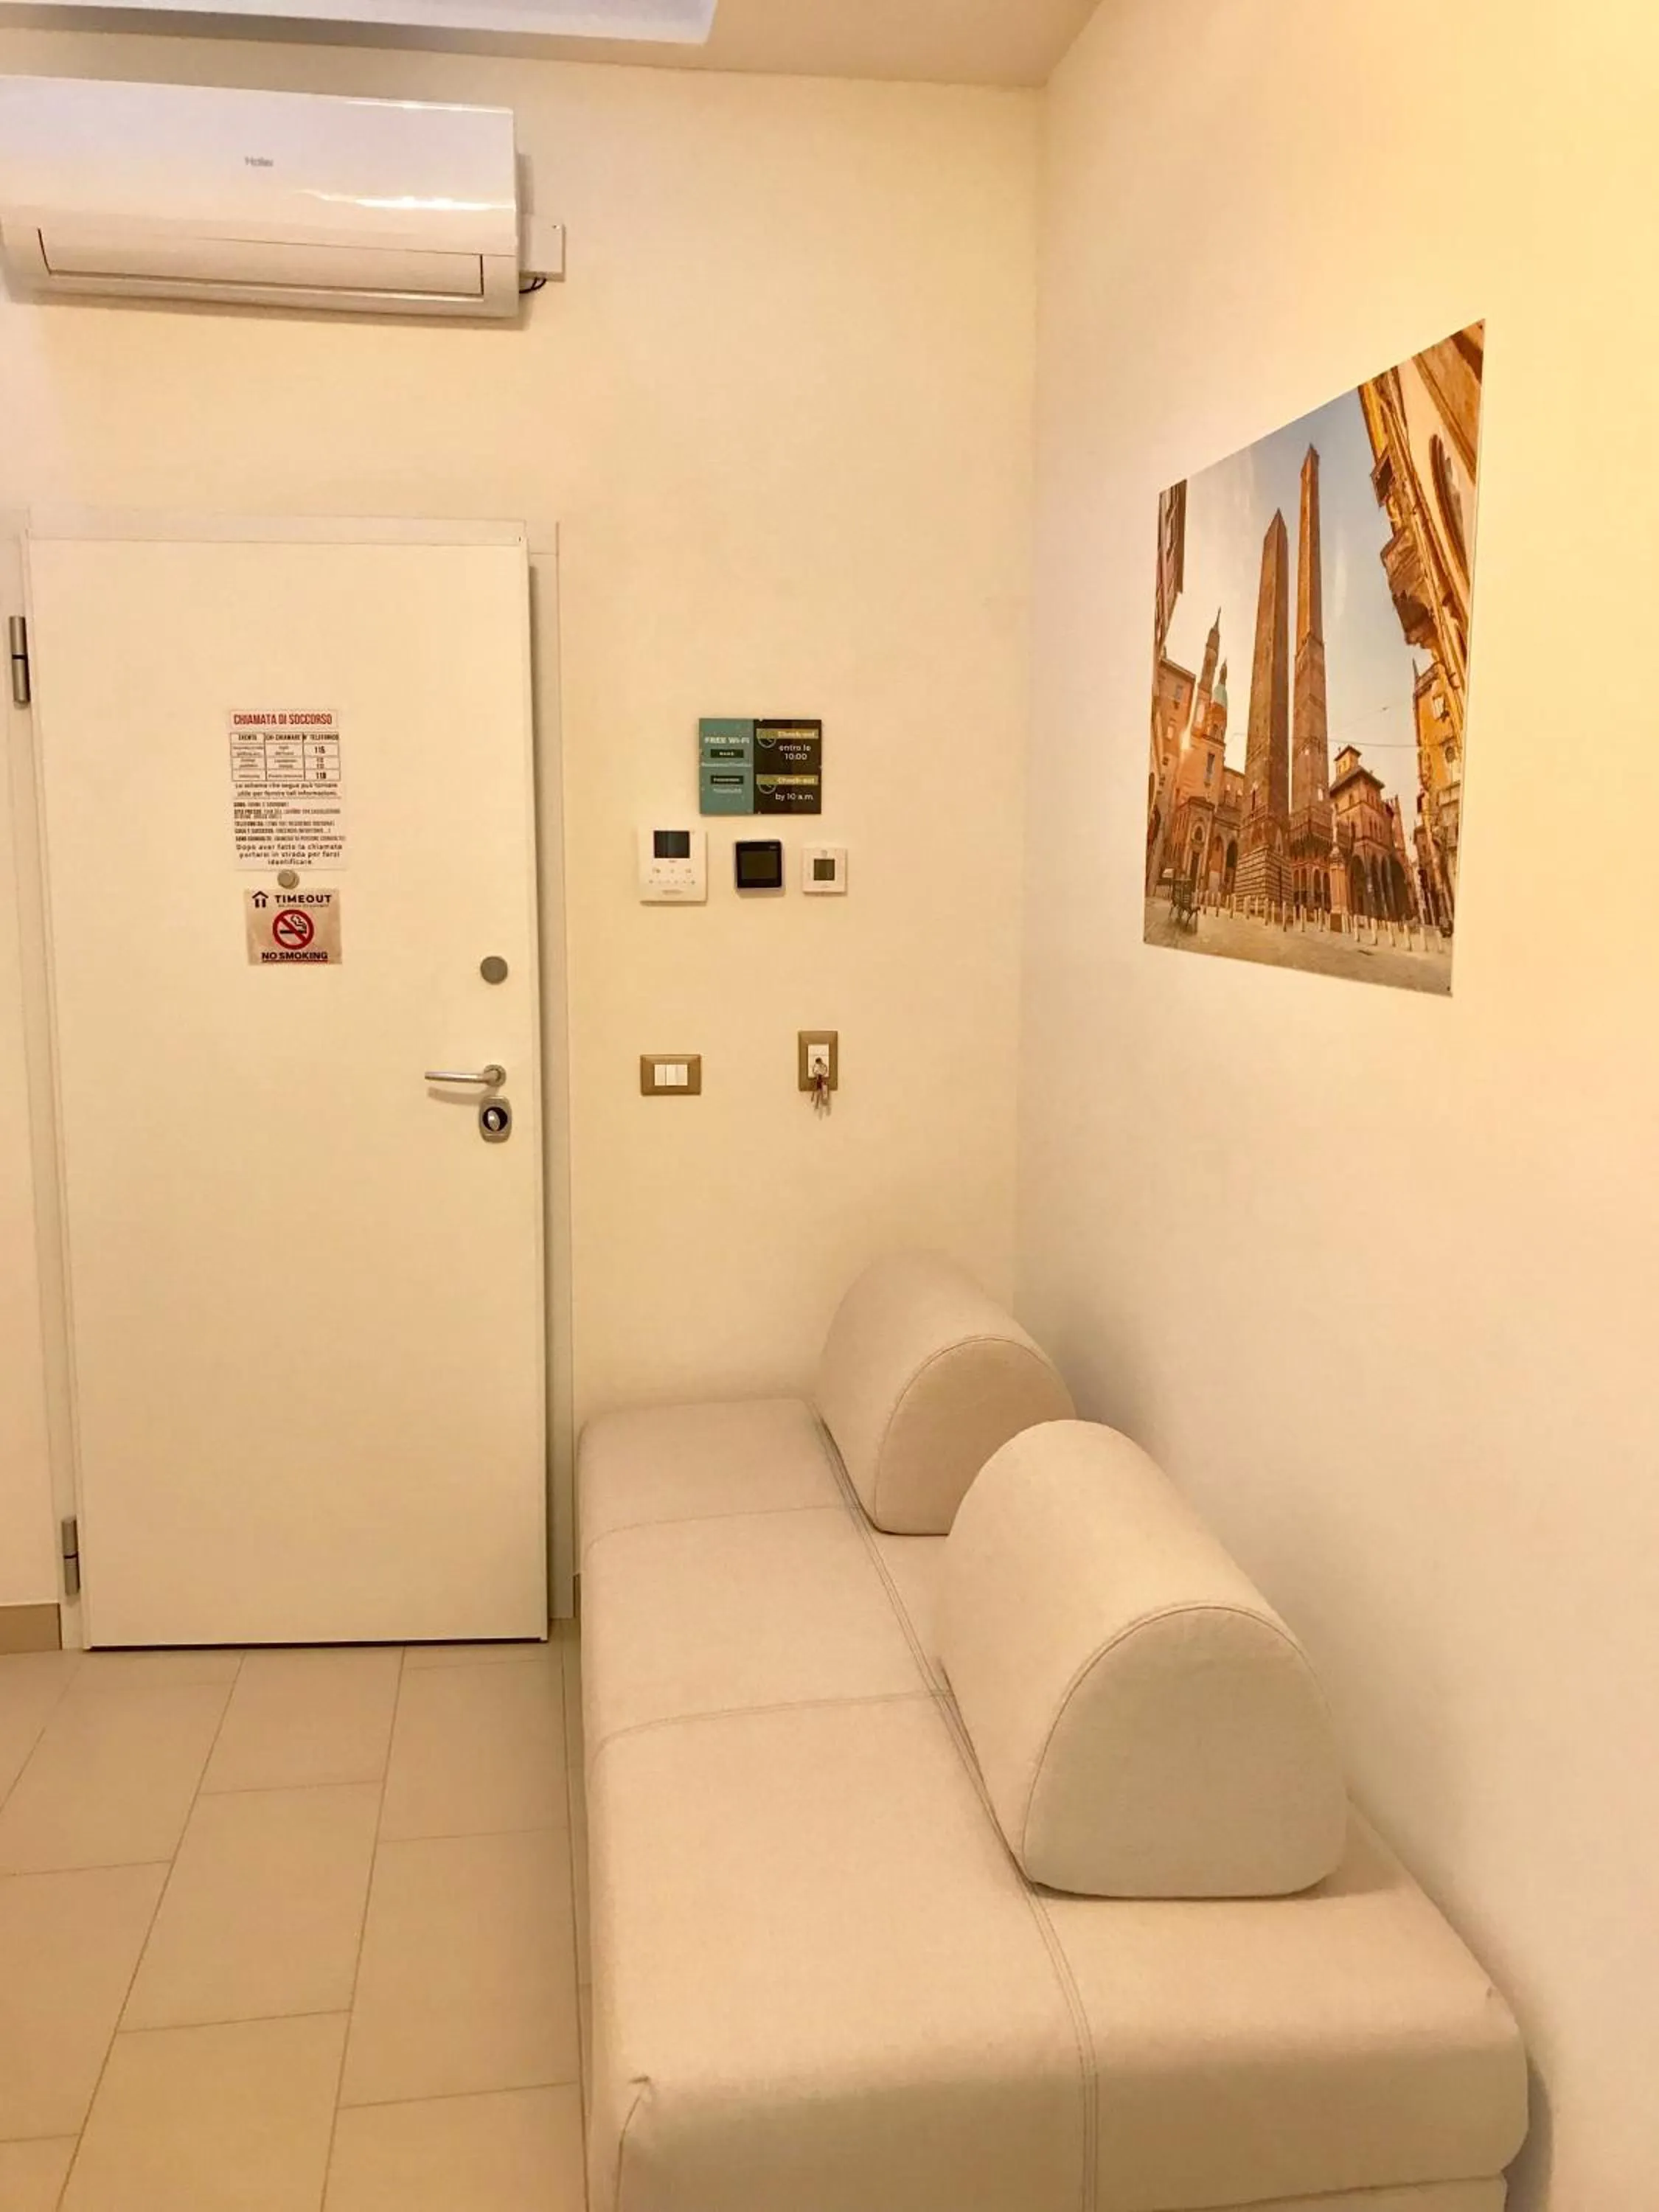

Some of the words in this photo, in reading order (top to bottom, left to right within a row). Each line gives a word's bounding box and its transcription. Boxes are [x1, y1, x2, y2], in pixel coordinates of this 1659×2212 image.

[234, 714, 276, 725] CHIAMATA
[279, 714, 287, 724] DI
[289, 714, 332, 725] SOCCORSO
[315, 745, 325, 754] 115
[776, 793, 785, 801] by
[274, 894, 332, 903] TIMEOUT
[261, 951, 278, 959] NO
[279, 951, 328, 959] SMOKING
